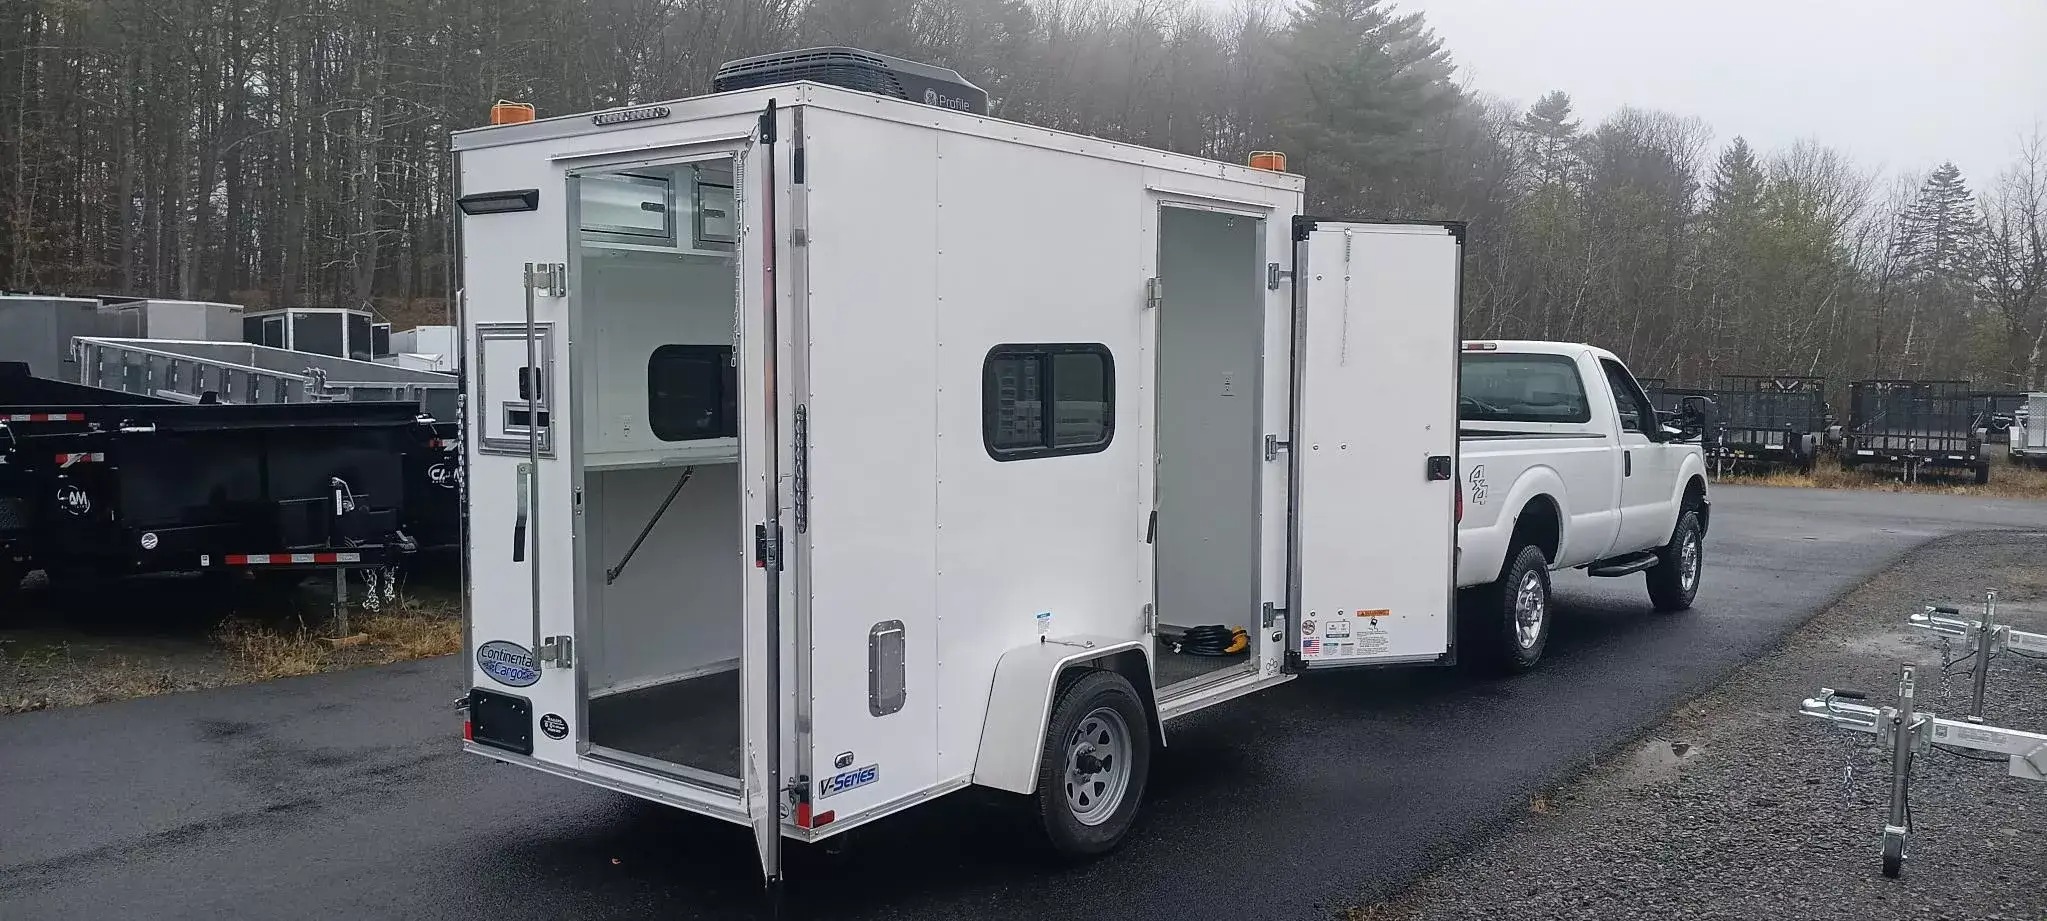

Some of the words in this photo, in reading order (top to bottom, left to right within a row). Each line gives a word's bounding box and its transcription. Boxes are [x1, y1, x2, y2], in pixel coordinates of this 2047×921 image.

[939, 94, 970, 111] Profile
[481, 645, 535, 668] Continenta
[494, 661, 523, 681] Cargo
[820, 767, 876, 796] V-Series
